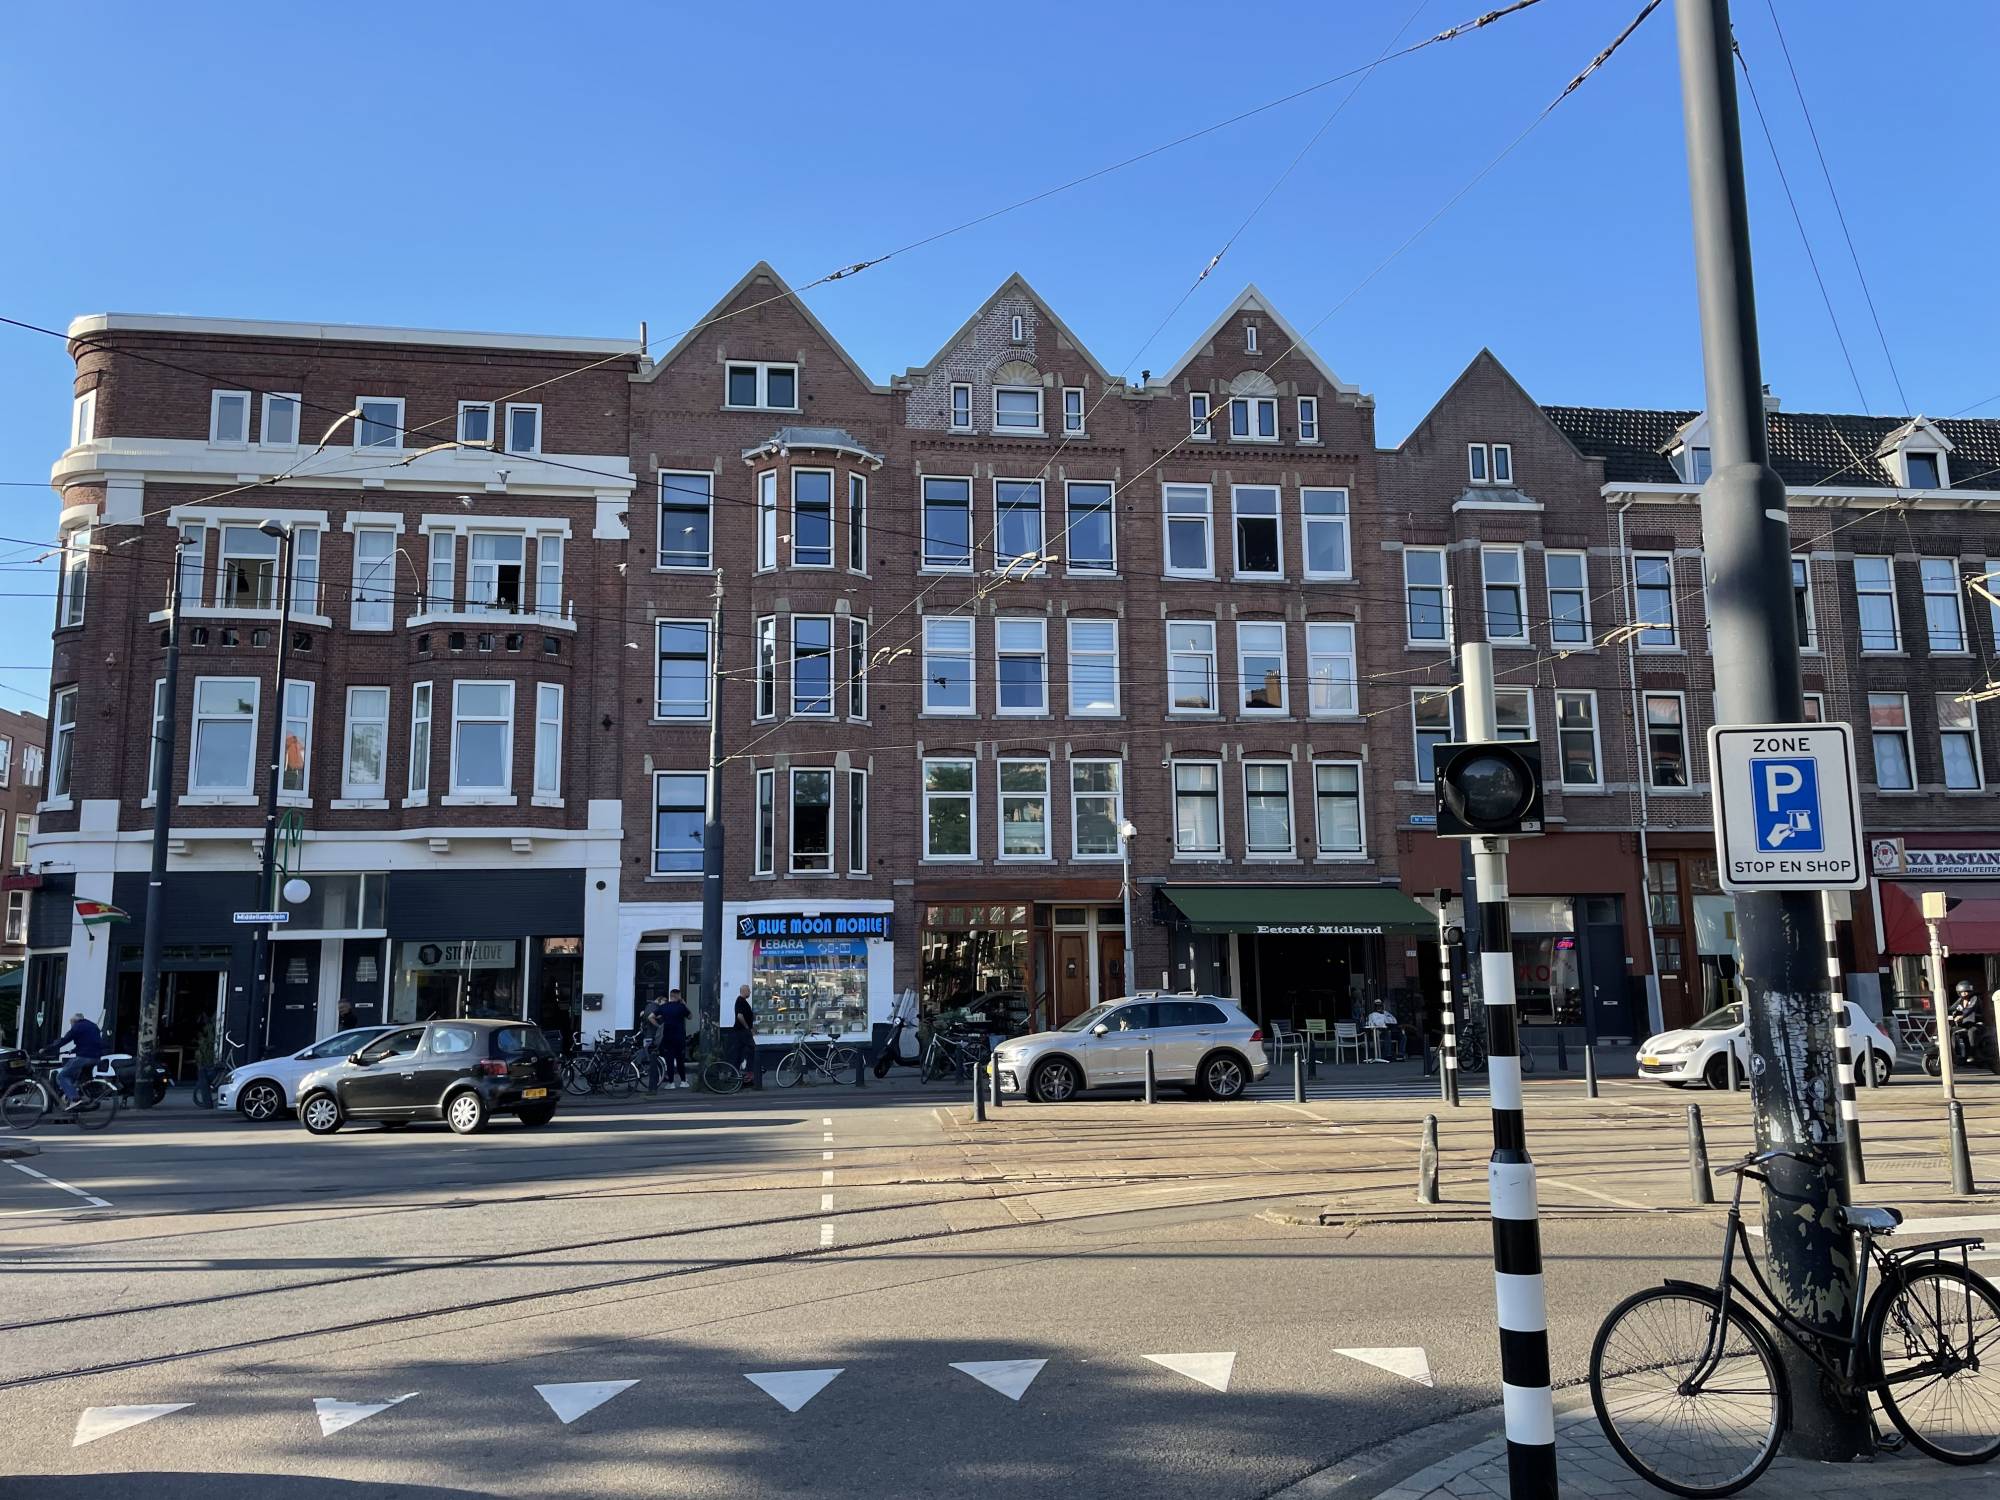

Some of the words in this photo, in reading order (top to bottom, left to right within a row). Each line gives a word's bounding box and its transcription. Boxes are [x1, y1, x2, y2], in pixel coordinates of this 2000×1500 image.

[1753, 738, 1810, 752] ZONE
[1765, 765, 1802, 812] P
[1735, 861, 1775, 873] STOP
[1780, 861, 1802, 872] EN
[1806, 860, 1851, 872] SHOP
[758, 919, 787, 934] BLUE
[790, 918, 832, 934] MOON
[835, 917, 882, 933] MOBILE
[1256, 925, 1315, 934] Eetcafé
[1318, 925, 1382, 934] Midland
[759, 938, 804, 949] LEBARA
